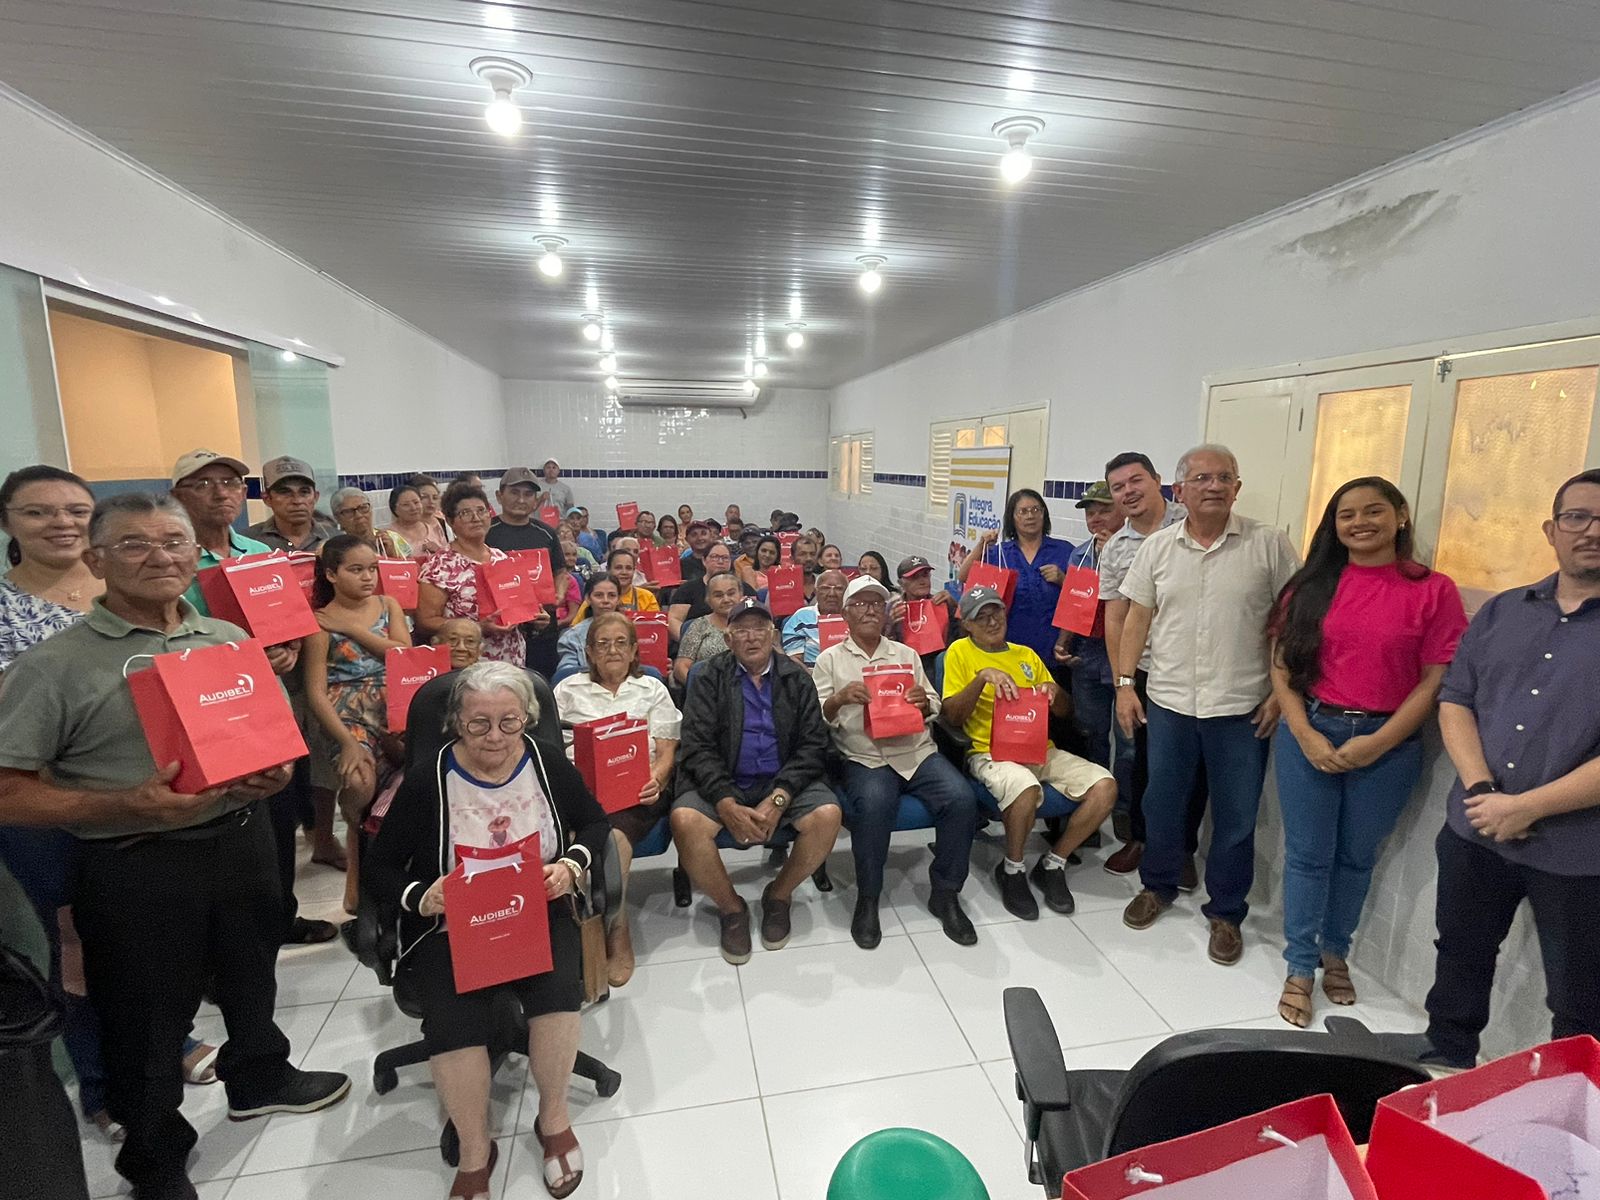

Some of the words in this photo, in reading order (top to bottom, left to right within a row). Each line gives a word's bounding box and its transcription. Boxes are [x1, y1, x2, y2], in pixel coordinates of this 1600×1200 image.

[969, 495, 993, 515] Integra
[968, 512, 1001, 530] Educação
[967, 528, 977, 540] PB
[249, 583, 281, 594] AUDIBEL
[199, 686, 251, 704] AUDIBEL
[470, 907, 518, 924] AUDIBEL
